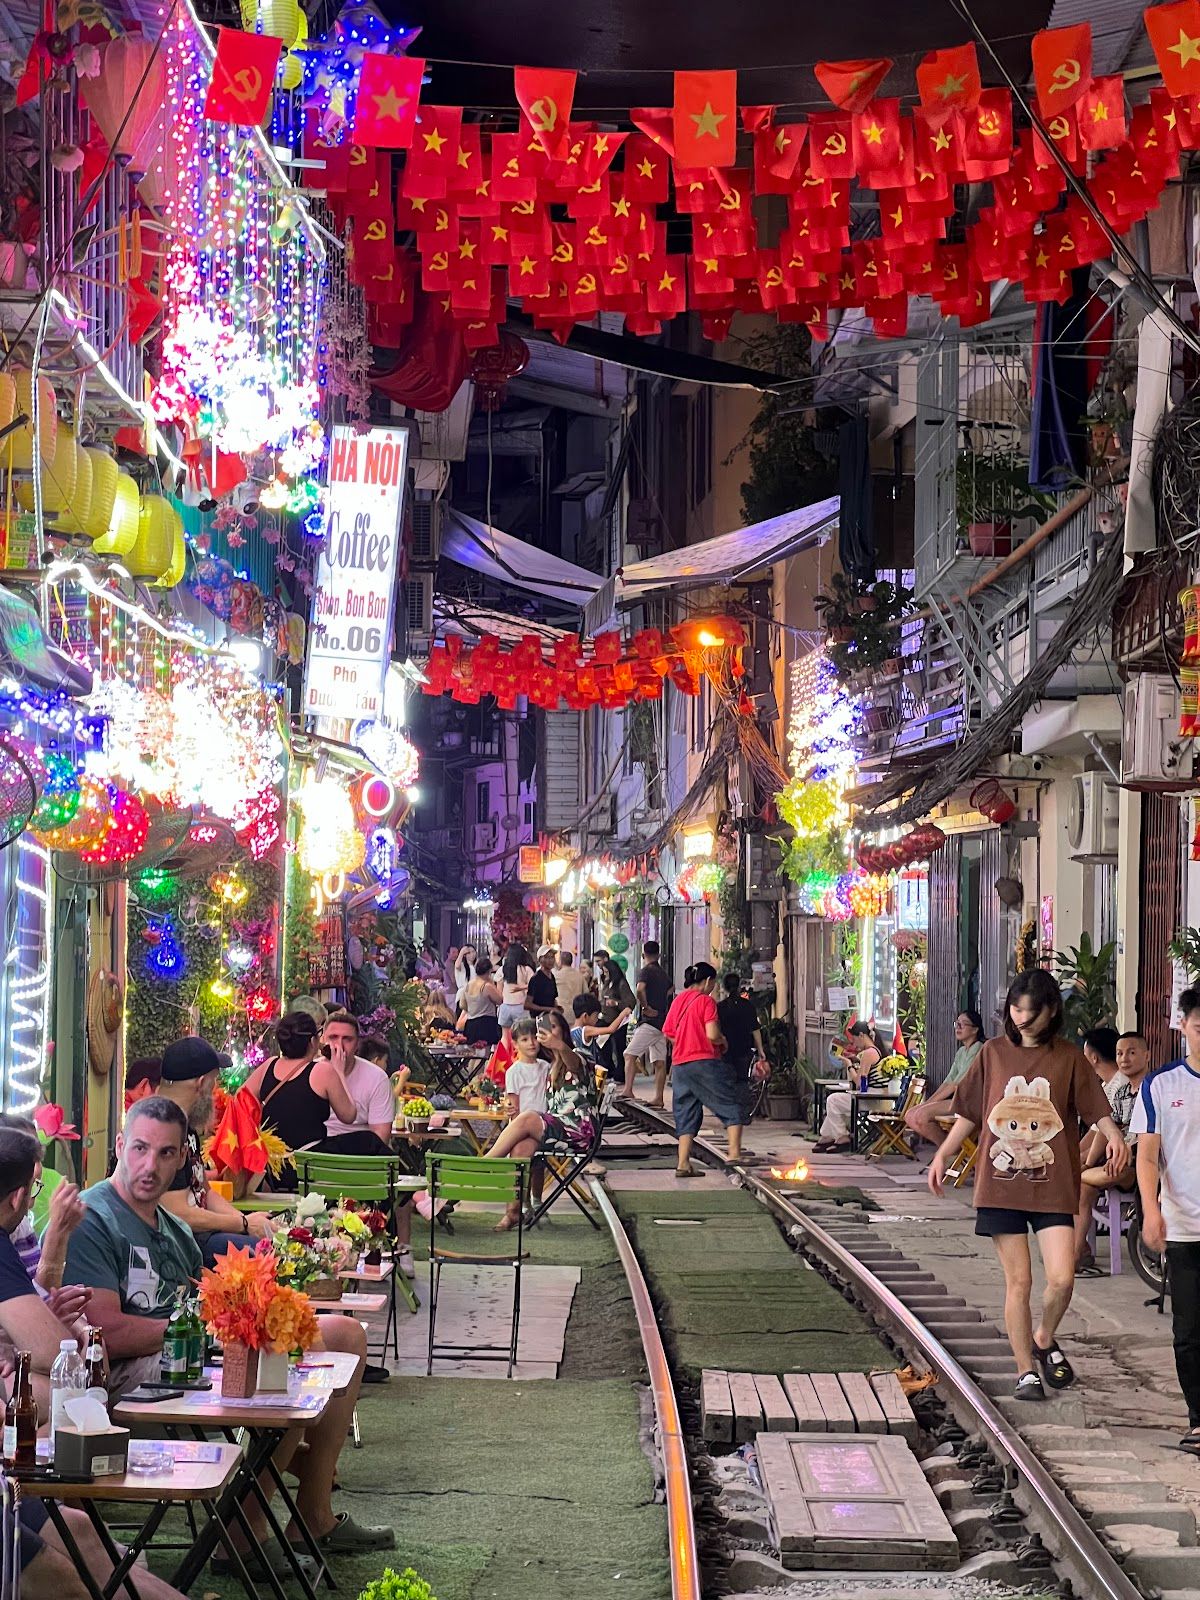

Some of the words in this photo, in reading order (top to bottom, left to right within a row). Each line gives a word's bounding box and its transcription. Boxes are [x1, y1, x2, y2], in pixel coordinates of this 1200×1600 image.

[331, 431, 358, 482] HÀ
[364, 433, 401, 496] NỘI
[325, 510, 391, 573] Coffee
[345, 589, 365, 617] Bon
[367, 590, 387, 620] Bon
